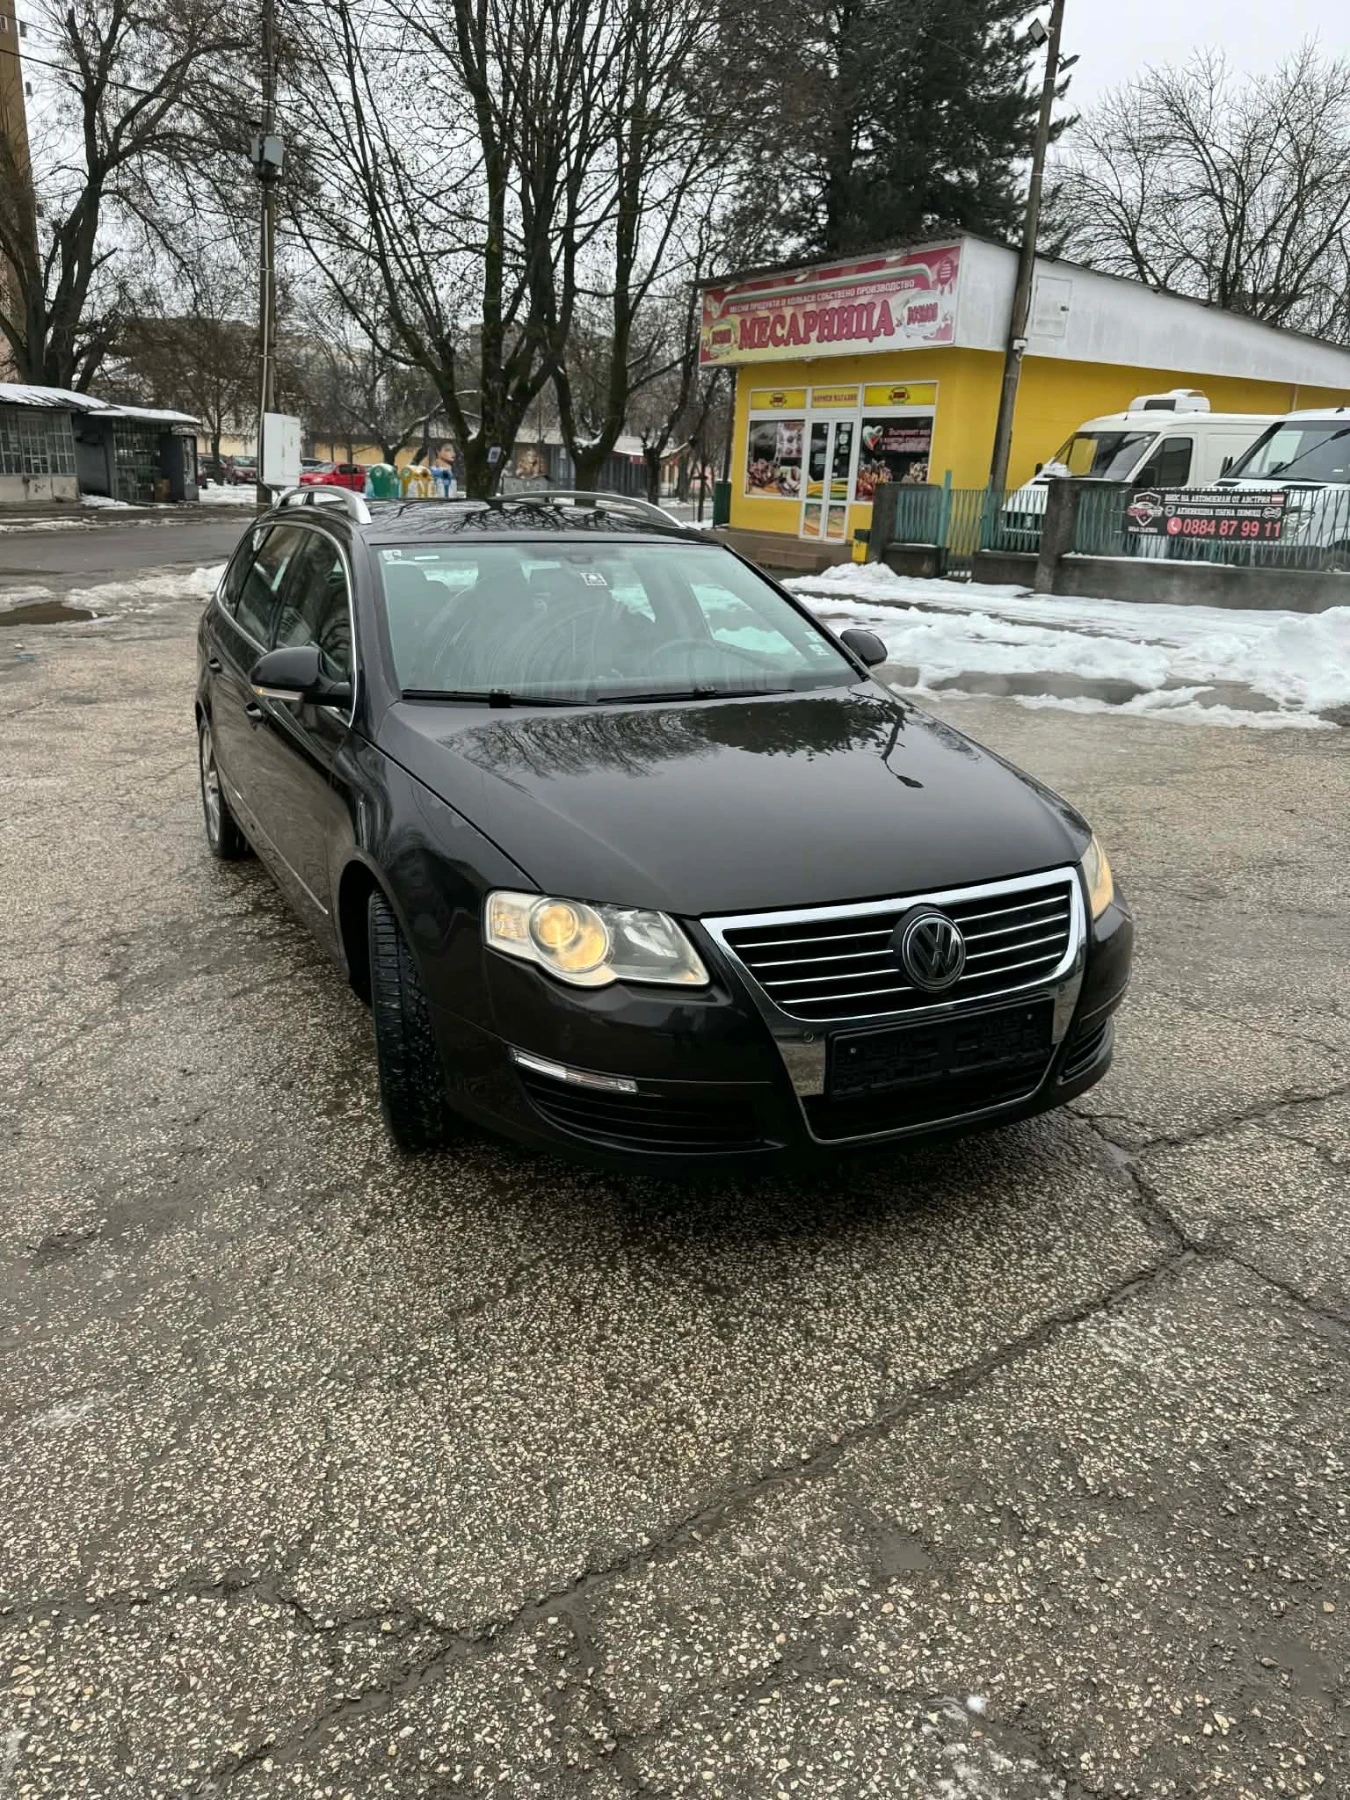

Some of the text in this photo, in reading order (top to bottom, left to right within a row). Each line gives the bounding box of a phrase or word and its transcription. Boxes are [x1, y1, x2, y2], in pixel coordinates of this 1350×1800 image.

[816, 288, 855, 302] СОБСТВЕНО
[856, 279, 915, 296] ПРОИЗВОДСТВО
[738, 300, 895, 350] МЕСАРНИЦА
[1183, 518, 1281, 537] 0884 87 99 11
